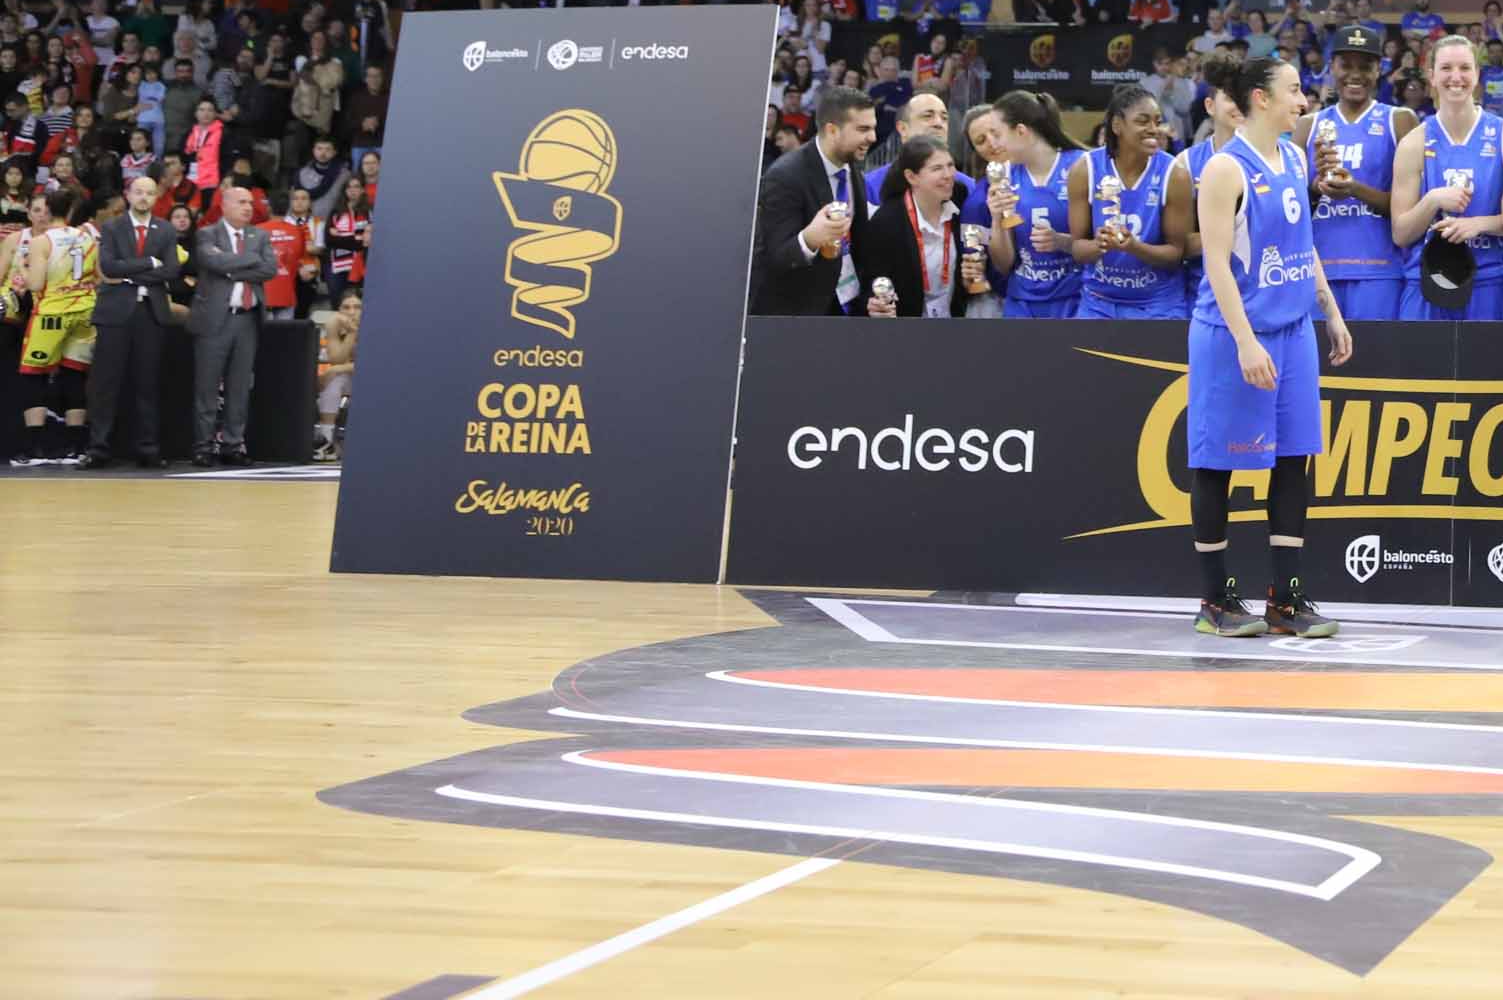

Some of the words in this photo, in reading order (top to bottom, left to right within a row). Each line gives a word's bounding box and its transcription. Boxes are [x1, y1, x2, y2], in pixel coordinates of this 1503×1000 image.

[621, 43, 689, 60] endesa
[1282, 187, 1301, 225] 6
[70, 247, 84, 281] 1
[494, 345, 584, 367] endesa
[477, 383, 585, 419] COPA
[466, 422, 487, 436] DE
[489, 422, 592, 454] REINA
[465, 437, 486, 453] LA
[787, 414, 1035, 473] endesa
[526, 517, 573, 535] 2020
[1383, 549, 1454, 564] baloncesto
